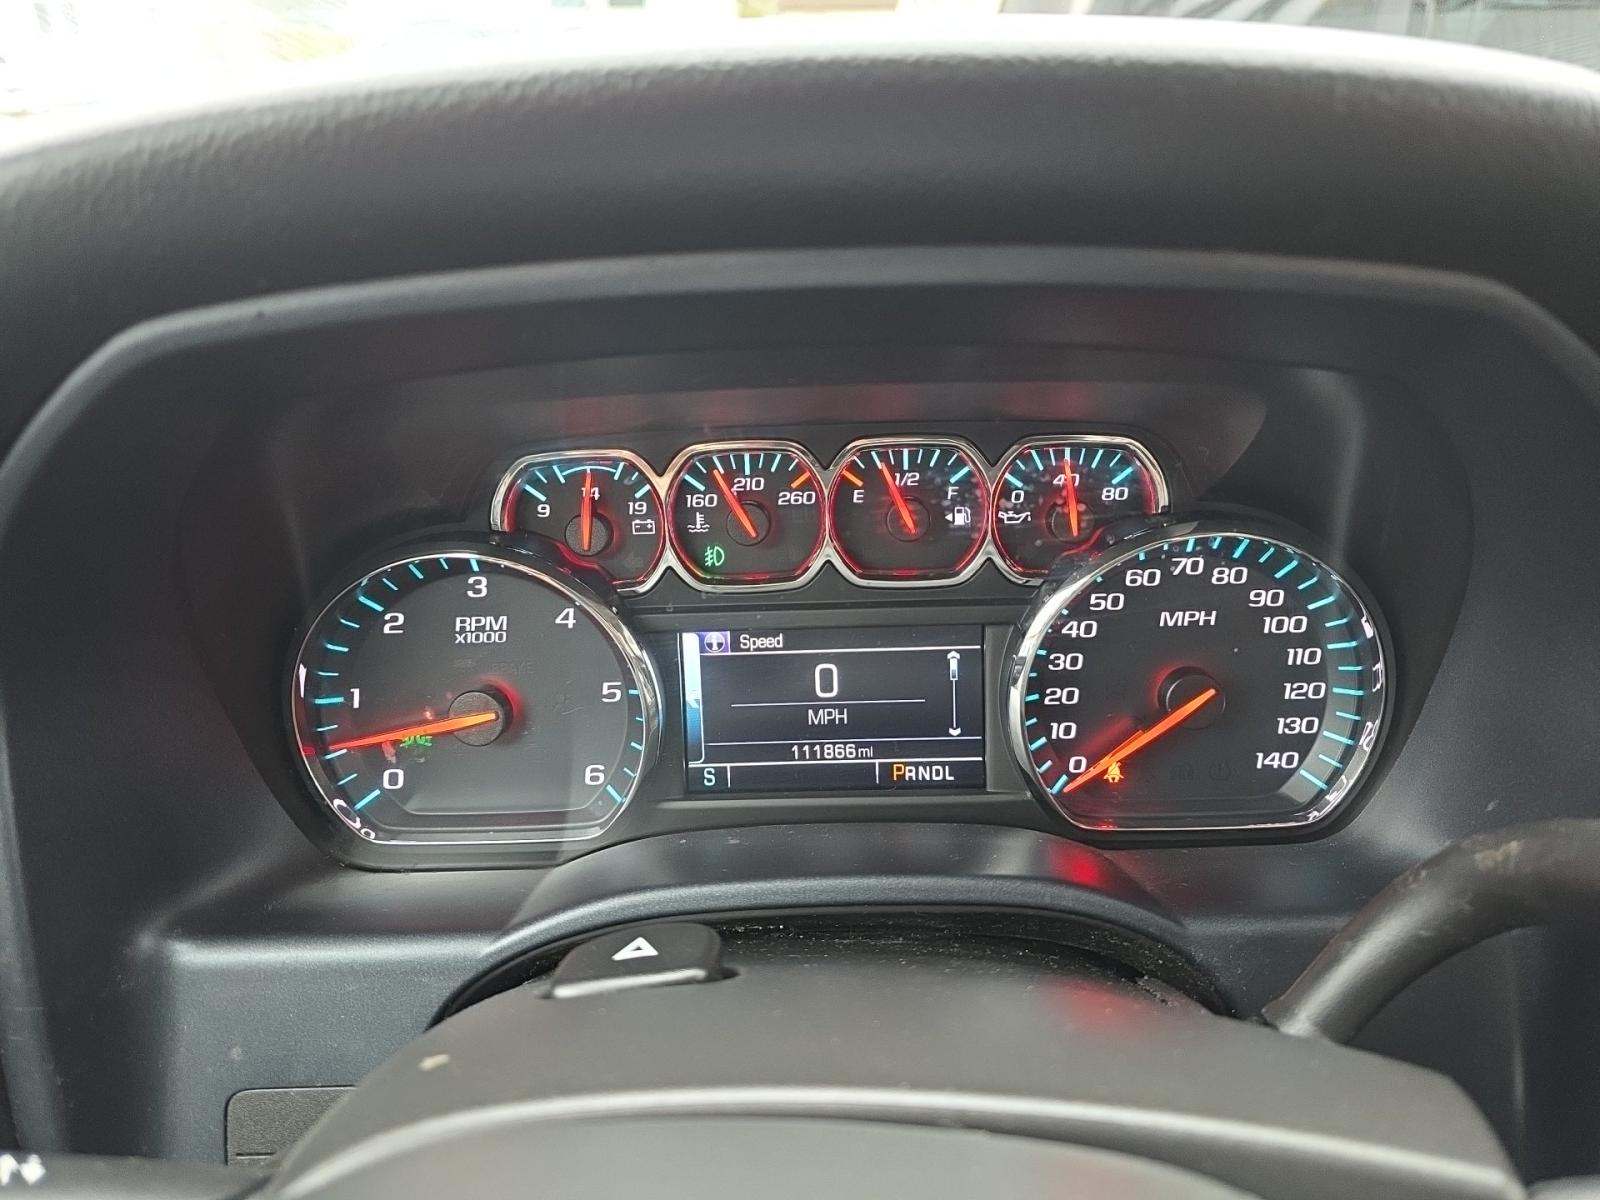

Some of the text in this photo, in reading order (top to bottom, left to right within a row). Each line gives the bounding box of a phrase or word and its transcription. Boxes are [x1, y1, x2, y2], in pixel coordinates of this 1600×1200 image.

[731, 477, 764, 490] 210
[895, 472, 919, 486] 1/2
[686, 494, 717, 507] 160
[778, 491, 816, 505] 260
[853, 490, 864, 503] E
[946, 487, 959, 499] F
[1010, 490, 1025, 503] 0
[1102, 487, 1128, 500] 80
[537, 500, 550, 517] 9
[628, 502, 647, 514] 19
[1171, 557, 1204, 575] 70
[1126, 569, 1161, 586] 60
[1212, 567, 1248, 584] 80
[467, 576, 487, 597] 3
[1090, 593, 1124, 610] 50
[1249, 590, 1284, 607] 90
[383, 613, 405, 633] 2
[455, 616, 507, 631] RPM
[555, 608, 576, 629] 4
[1160, 611, 1216, 626] MPH
[1263, 616, 1307, 633] 100
[455, 631, 506, 644] x1000
[1062, 621, 1097, 637] 40
[740, 633, 784, 650] Speed
[1049, 653, 1083, 670] 30
[1287, 648, 1321, 665] 110
[815, 663, 839, 698] 0
[351, 688, 359, 708] 1
[601, 682, 623, 702] 5
[1044, 688, 1079, 704] 20
[1284, 682, 1326, 699] 120
[808, 708, 847, 725] MPH
[1051, 722, 1077, 739] 10
[1277, 717, 1319, 734] 130
[1069, 756, 1087, 773] 0
[1256, 752, 1299, 769] 140
[383, 769, 405, 789] 0
[584, 765, 606, 785] 6
[704, 768, 715, 786] S
